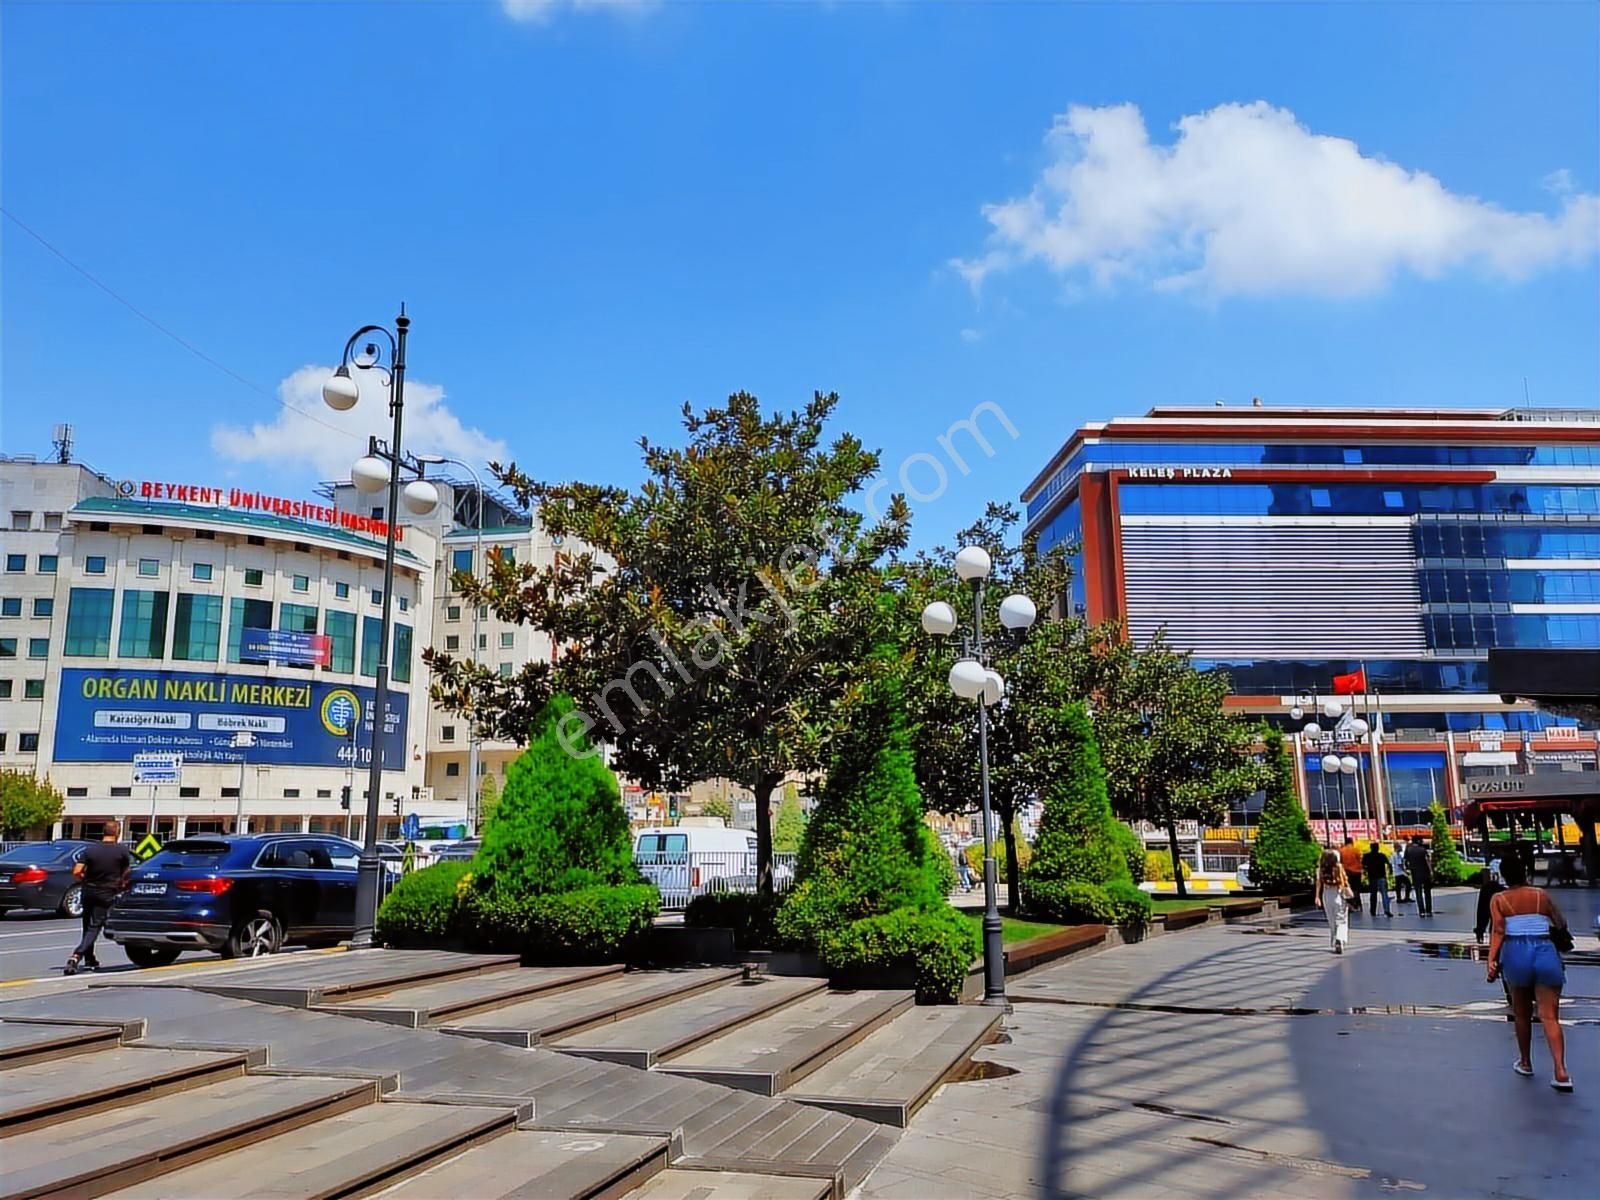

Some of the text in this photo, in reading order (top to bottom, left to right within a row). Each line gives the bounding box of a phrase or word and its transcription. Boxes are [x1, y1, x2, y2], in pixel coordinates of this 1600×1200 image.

[1128, 467, 1232, 480] KELEŞ PLAZA
[141, 481, 403, 542] BEYKENT ÜNİVERSİTESİ HASTANSİ
[82, 677, 311, 708] ORGAN NAKLİ MERKEZİ
